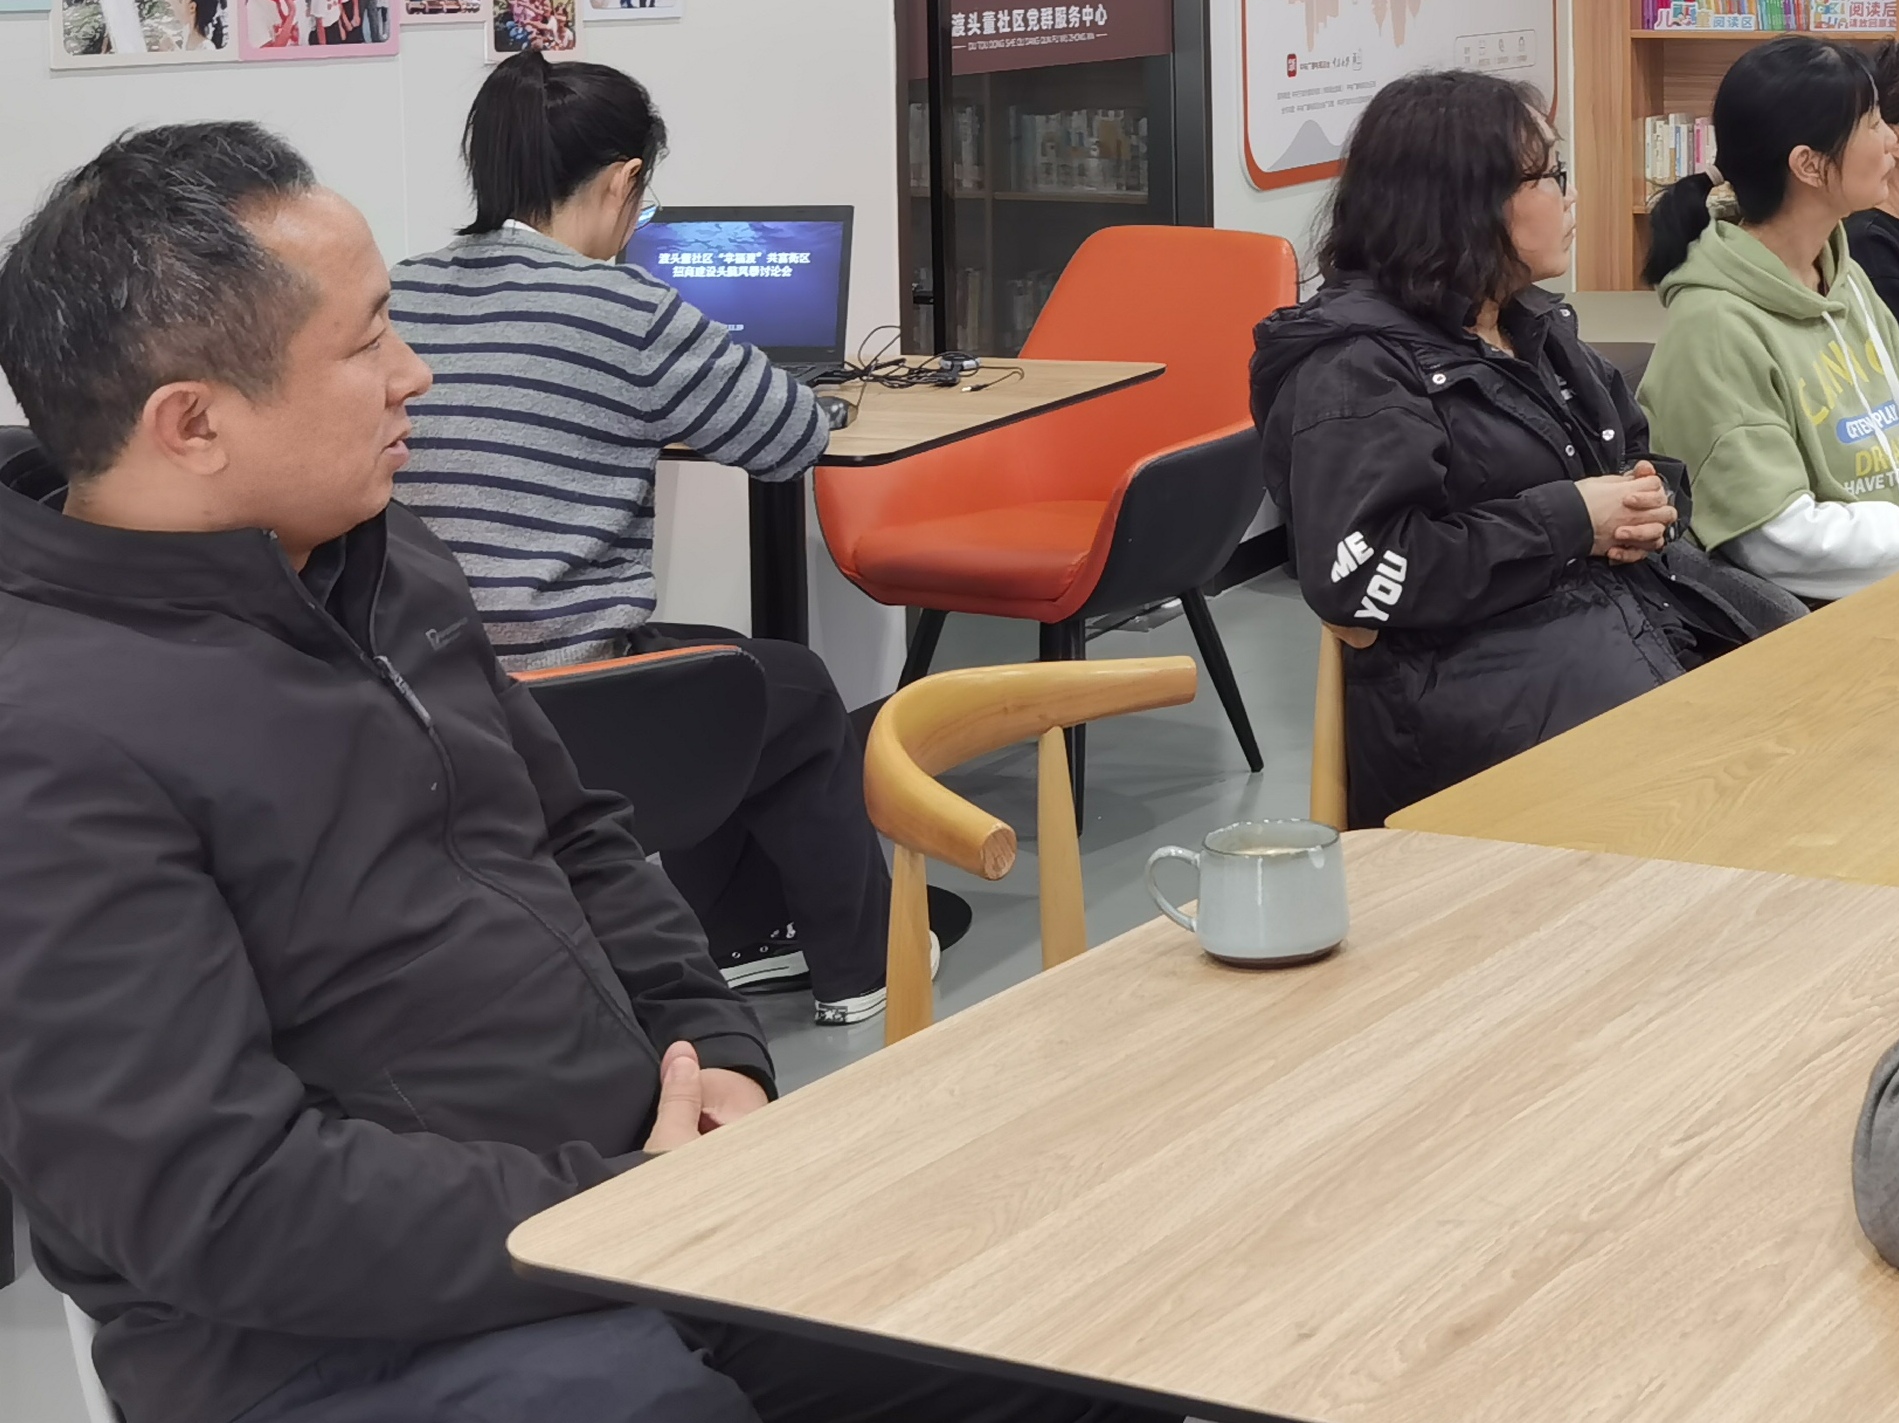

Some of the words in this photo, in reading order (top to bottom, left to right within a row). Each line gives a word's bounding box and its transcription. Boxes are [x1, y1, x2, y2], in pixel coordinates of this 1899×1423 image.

[951, 3, 1108, 38] 渡头董社区党群服务中心
[1713, 16, 1753, 28] 阅读区
[1331, 531, 1375, 583] ME
[1354, 550, 1407, 622] YOU
